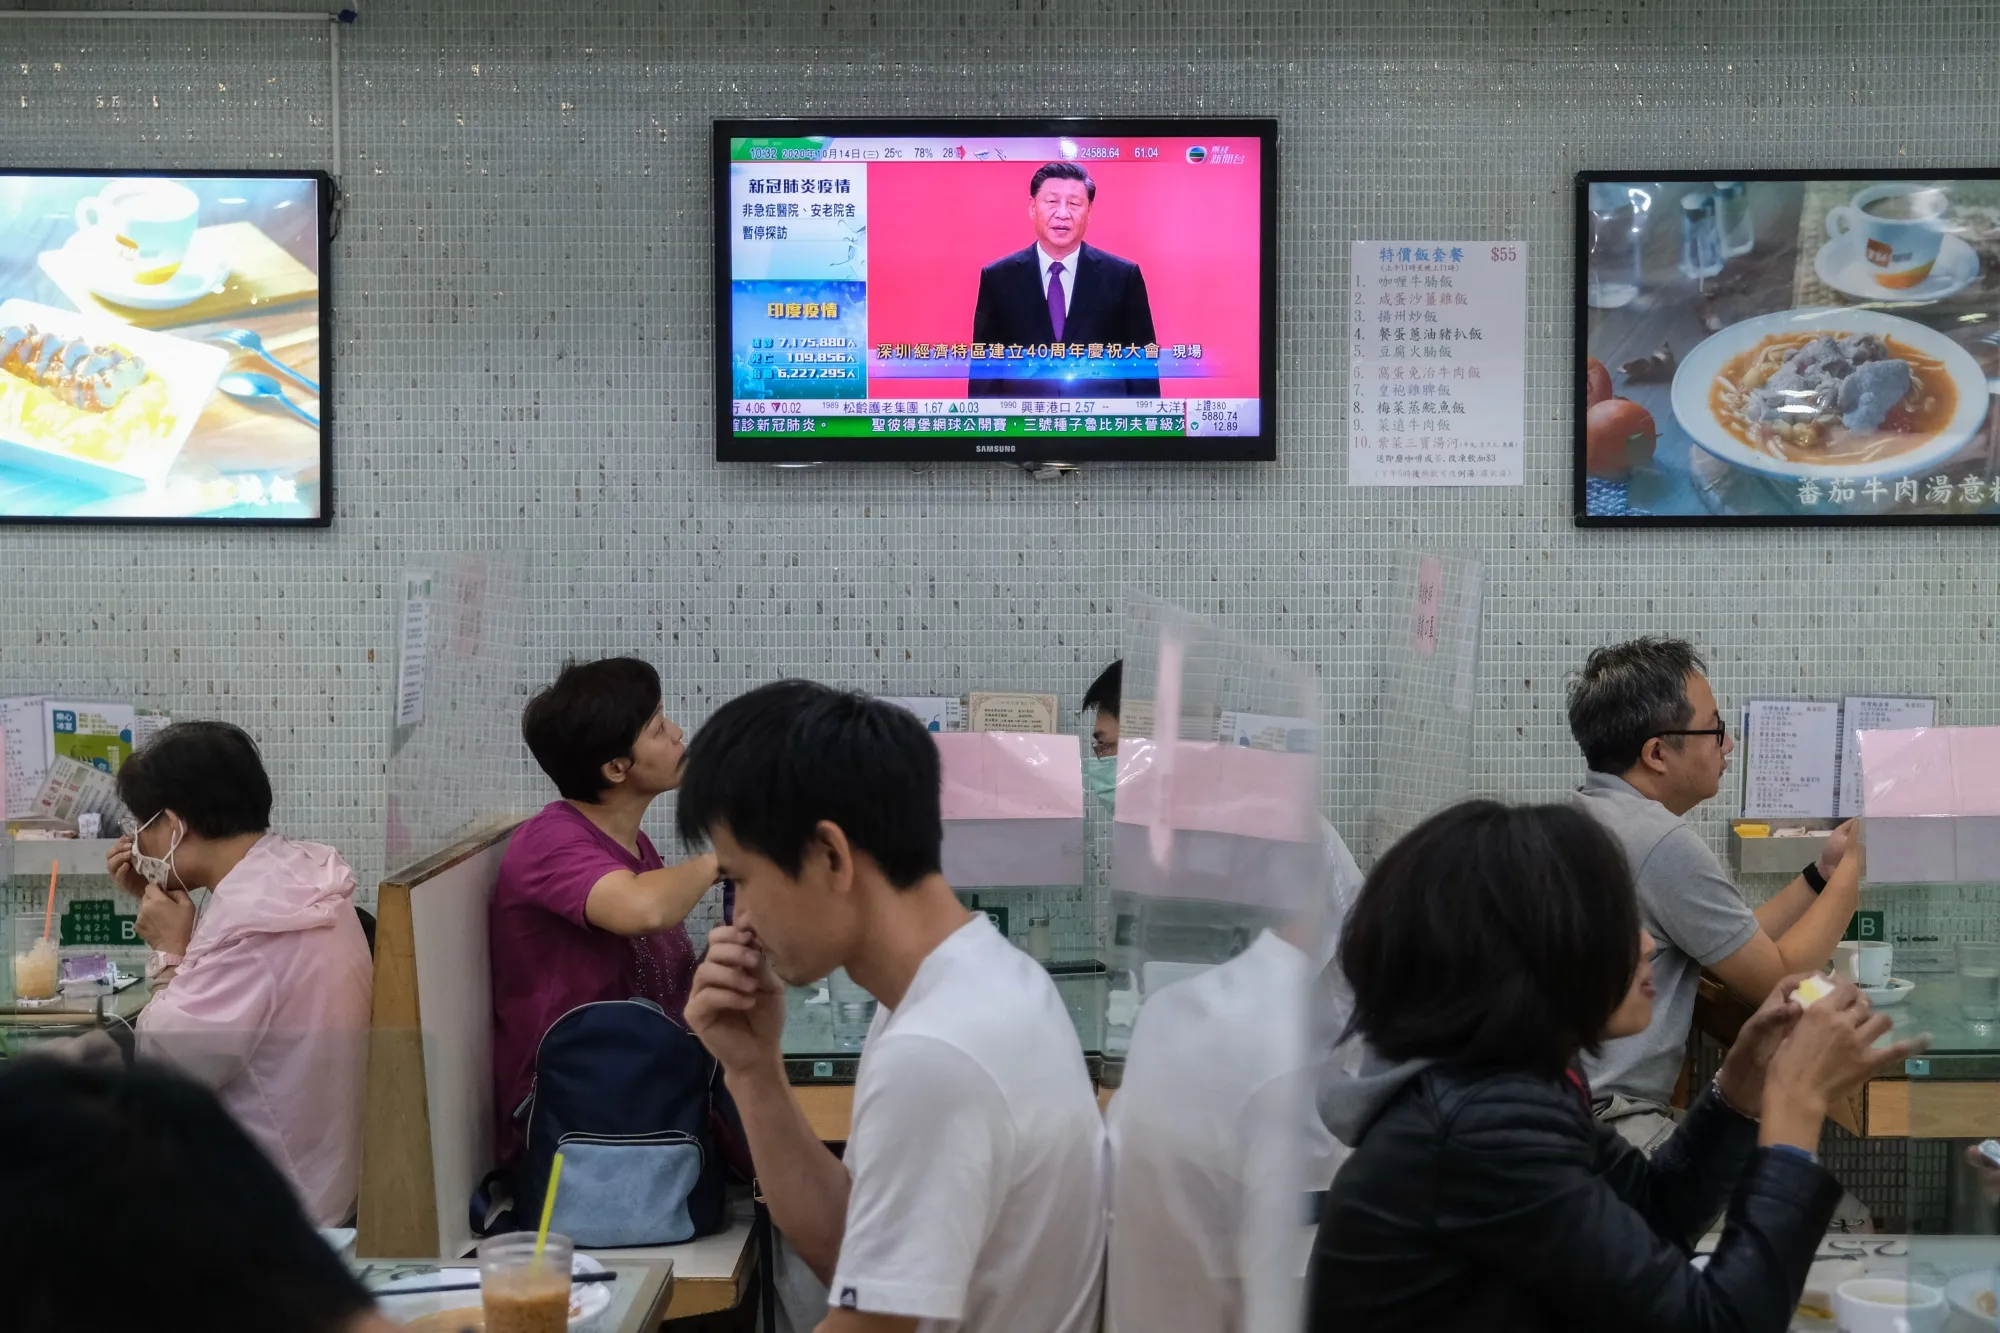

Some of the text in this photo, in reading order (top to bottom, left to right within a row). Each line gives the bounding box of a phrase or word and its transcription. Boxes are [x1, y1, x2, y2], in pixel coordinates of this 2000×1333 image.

[750, 146, 776, 159] 10:32
[914, 148, 934, 159] 78%
[1080, 148, 1120, 159] 24588.64
[1134, 148, 1158, 158] 61.04
[748, 178, 851, 194] 新冠肺炎疫情
[742, 203, 856, 218] 非急症醫院、安老院舍
[742, 225, 788, 240] 暫停探訪
[1379, 246, 1517, 263] 特價飯套餐 $55
[1355, 274, 1453, 288] 1. 咖喱牛腩飯
[1355, 292, 1365, 305] 2.
[767, 303, 838, 318] 印度疫情
[1354, 310, 1365, 323] 3.
[1354, 328, 1365, 340] 4.
[876, 342, 1202, 360] 深圳經濟特區建立40周年慶祝大會 現場
[1354, 345, 1453, 359] 5. 豆腐火腩飯
[1353, 367, 1364, 380] 6.
[1353, 384, 1364, 397] 7.
[745, 403, 766, 414] 4.06
[781, 402, 802, 414] 0.02
[843, 402, 918, 414] 松齡護老集團
[924, 402, 943, 414] 1.67
[959, 402, 979, 414] 0.03
[1000, 401, 1017, 409] 1990
[1021, 401, 1071, 414] 興華港口
[1075, 401, 1095, 413] 2.57
[1353, 402, 1364, 414] 8.
[1201, 411, 1238, 421] 5880.74
[1213, 421, 1238, 431] 12.89
[1353, 419, 1364, 432] 9.
[1353, 436, 1371, 449] 10.
[121, 920, 136, 940] B
[1861, 917, 1876, 936] B
